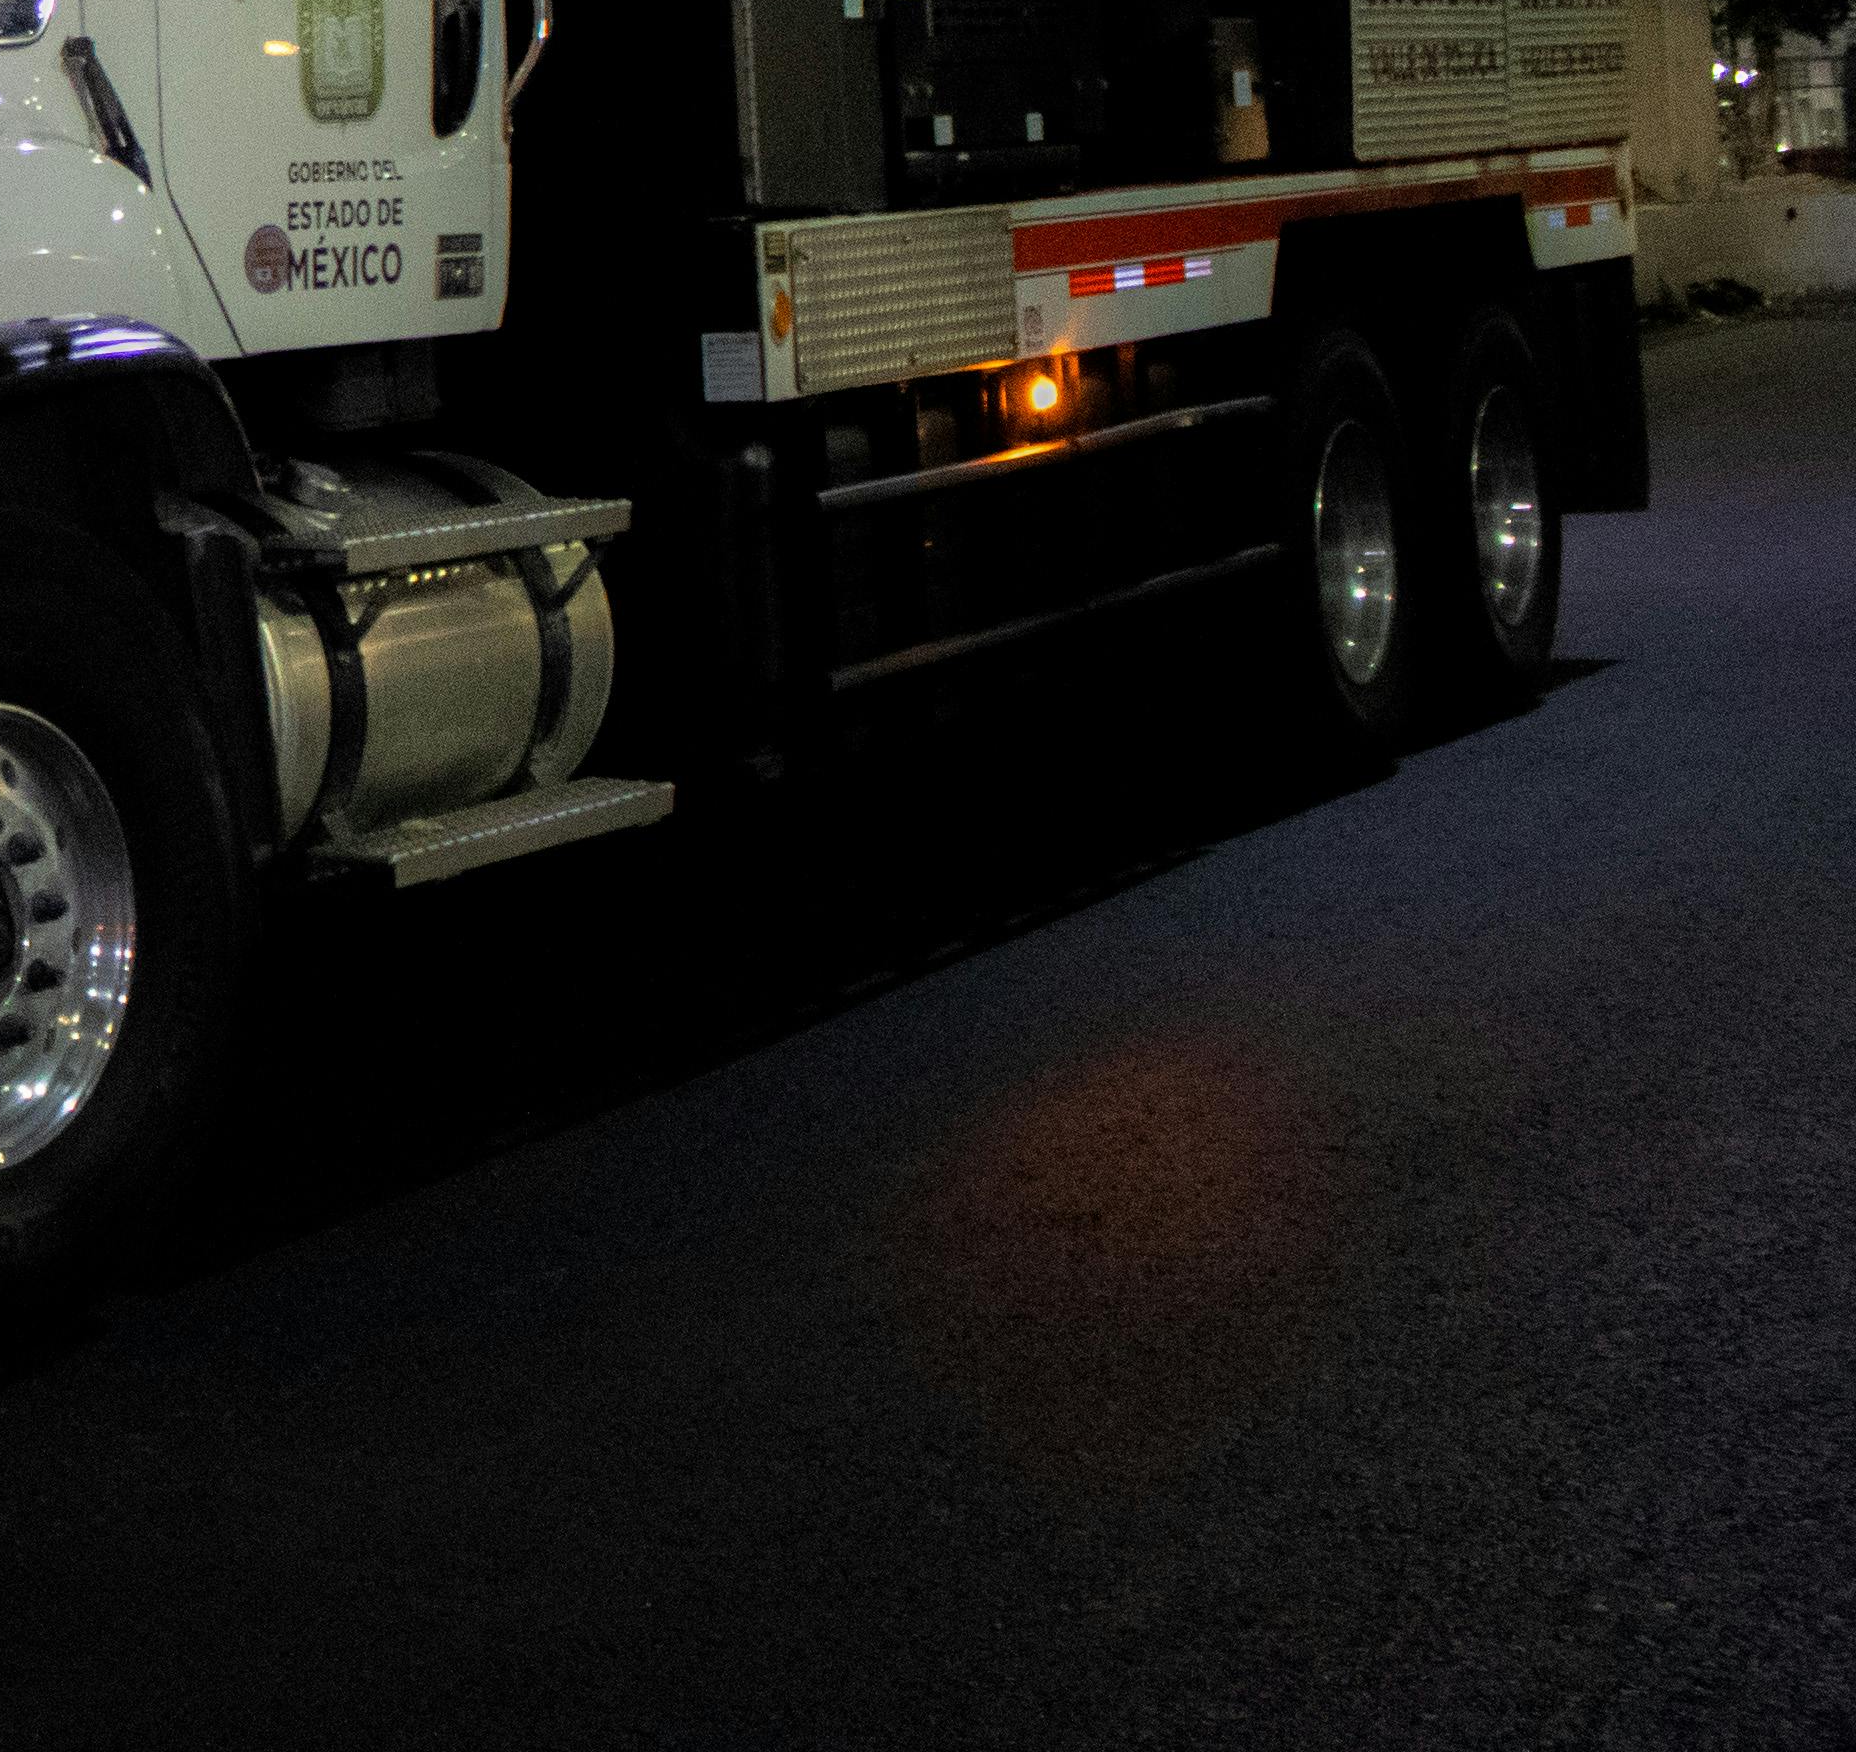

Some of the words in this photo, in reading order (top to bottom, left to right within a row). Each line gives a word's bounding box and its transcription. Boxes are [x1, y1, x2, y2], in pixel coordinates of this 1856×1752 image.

[288, 162, 369, 183] GOBIERNO
[373, 159, 403, 182] DEL
[287, 199, 371, 231] ESTADO
[375, 197, 404, 227] DE
[287, 235, 403, 291] MÉXICO
